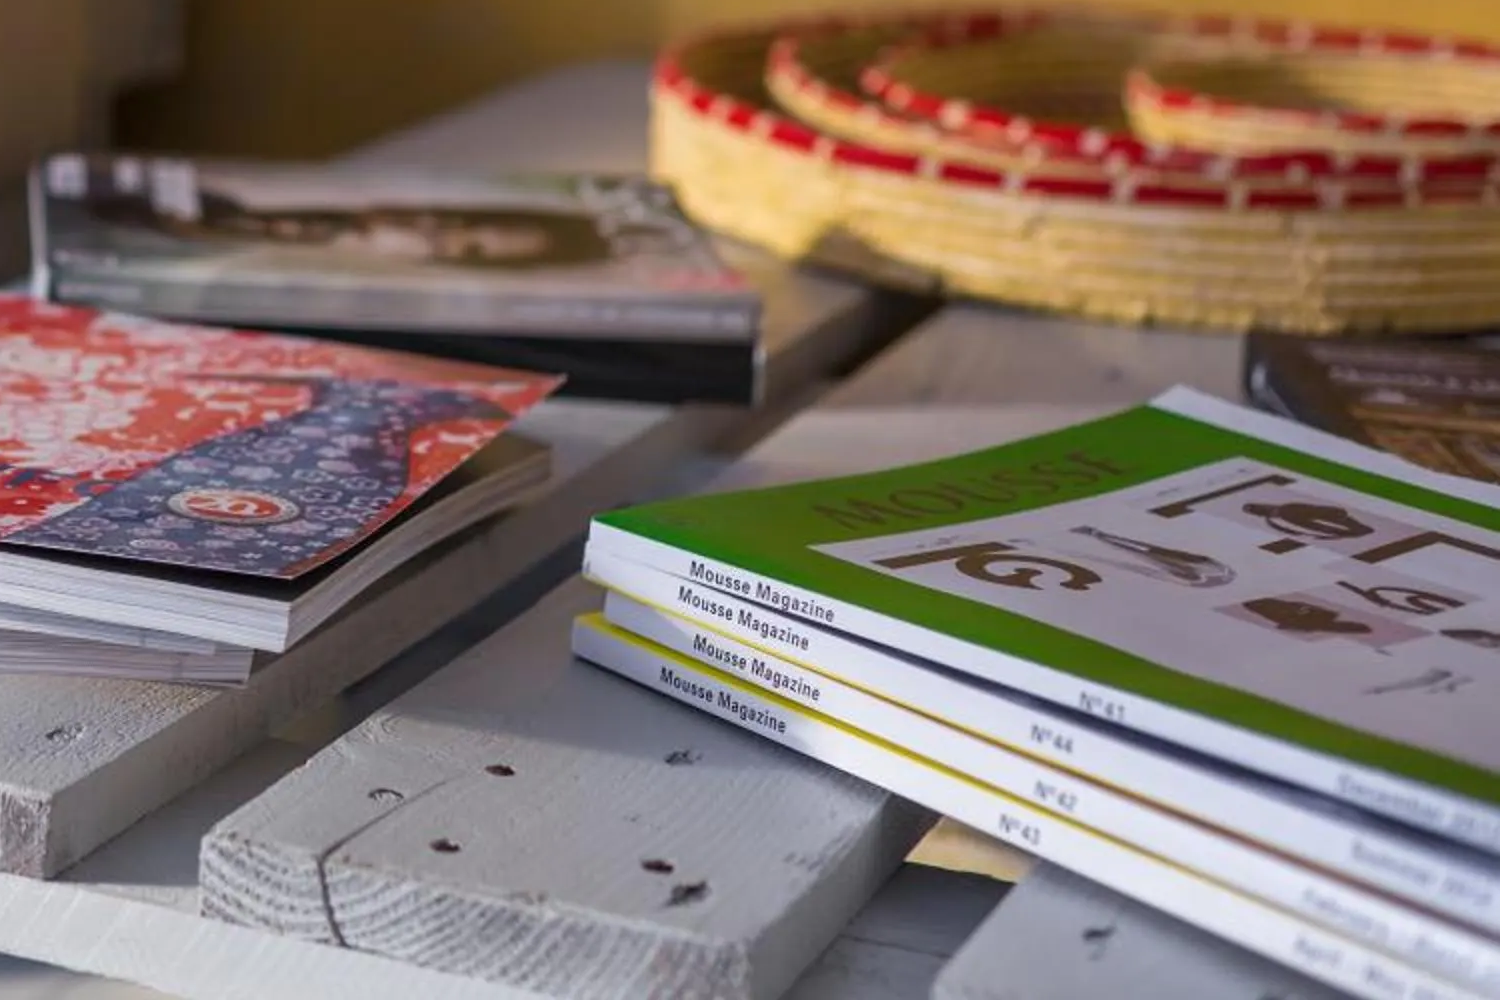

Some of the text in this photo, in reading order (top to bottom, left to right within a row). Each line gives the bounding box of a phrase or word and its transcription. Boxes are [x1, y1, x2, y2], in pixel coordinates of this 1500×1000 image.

[812, 450, 1125, 531] MOUSSE
[677, 586, 733, 621] Mousse
[738, 609, 810, 650] Magazine
[689, 560, 751, 594] Mousse
[756, 581, 835, 622] Magazine
[660, 666, 714, 702] Mousse
[717, 691, 787, 734] Magazine
[693, 634, 746, 669] Mousse
[751, 658, 821, 702] Magazine
